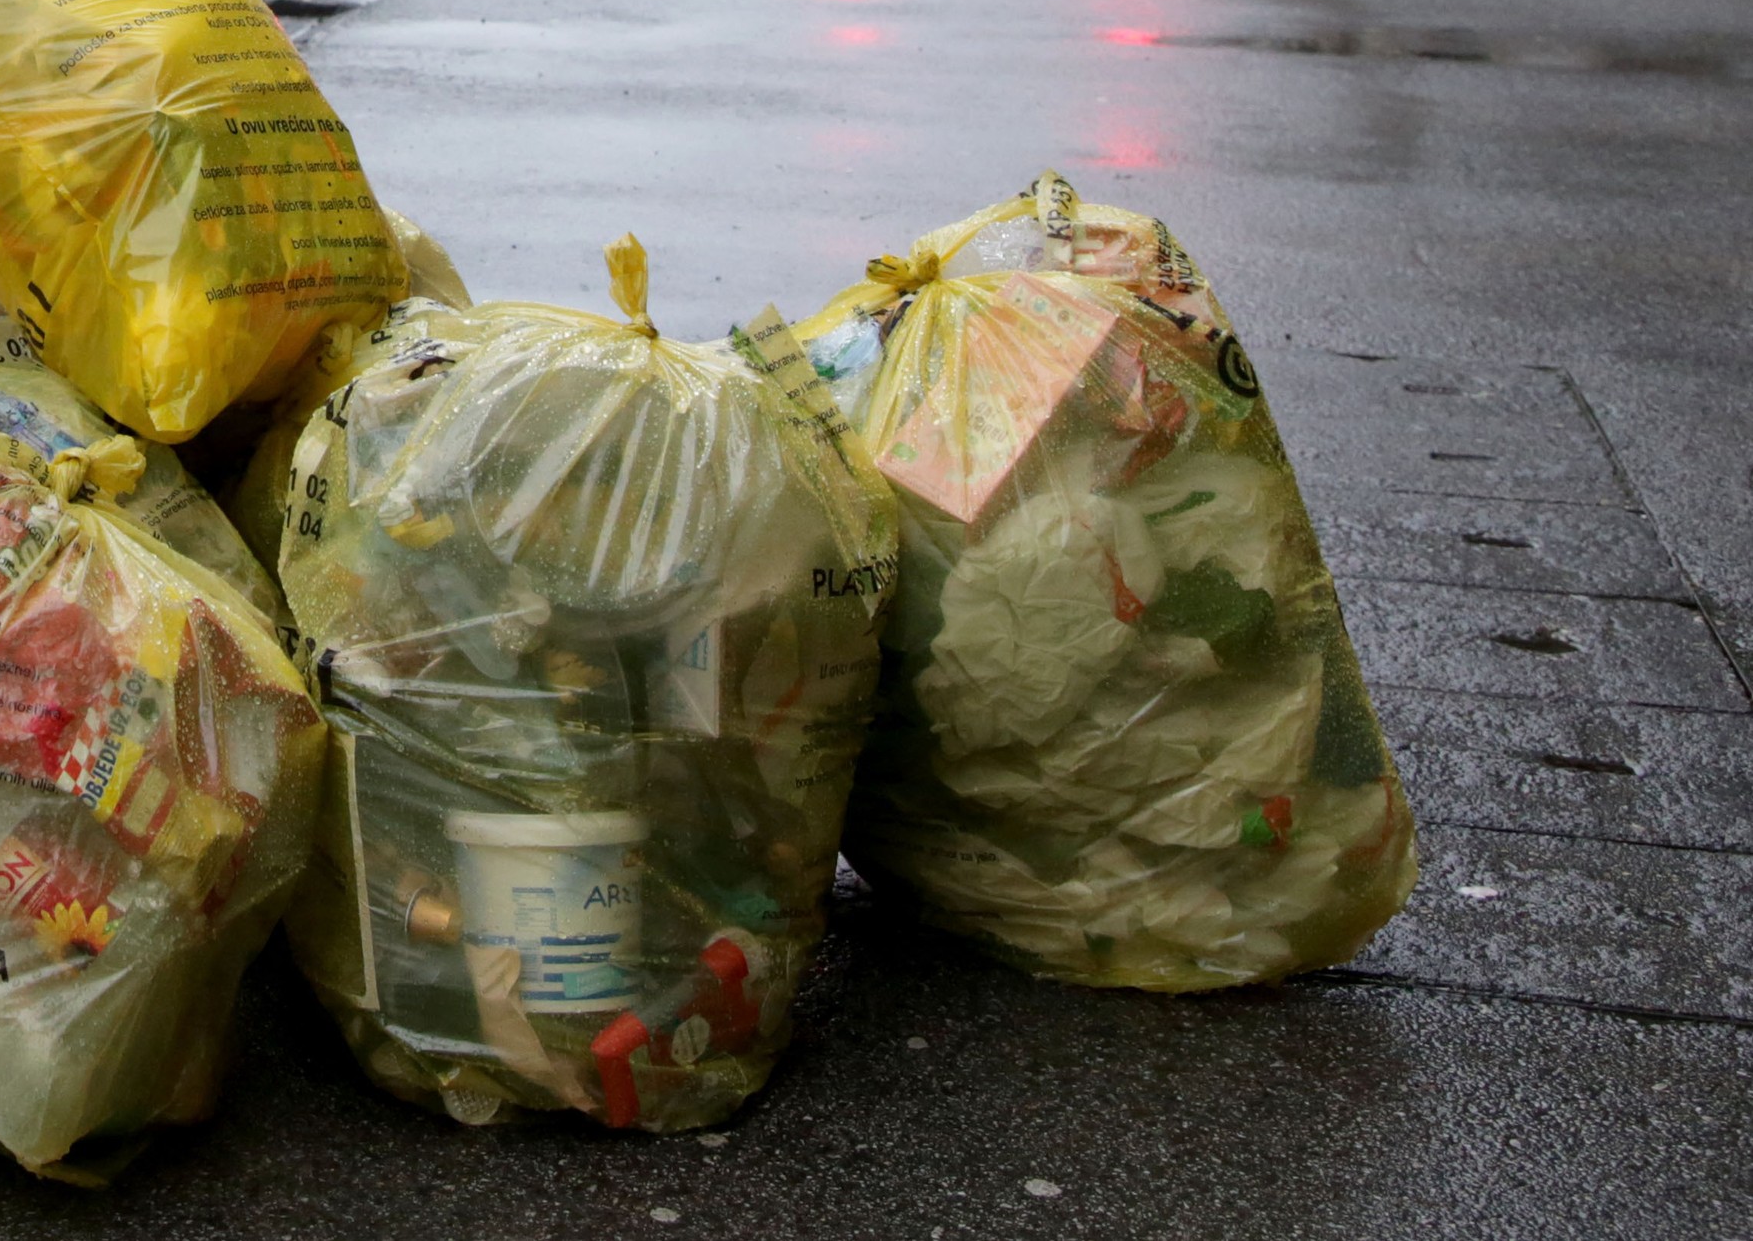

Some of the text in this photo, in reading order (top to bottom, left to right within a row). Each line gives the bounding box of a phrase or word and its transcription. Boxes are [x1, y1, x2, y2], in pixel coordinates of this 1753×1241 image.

[57, 29, 116, 77] podloške
[224, 118, 238, 135] U
[241, 120, 266, 134] ovu
[317, 119, 334, 132] ne
[200, 165, 235, 180] tapete,
[234, 205, 247, 215] za
[753, 322, 787, 342] spužve,
[305, 473, 329, 505] 02
[298, 511, 323, 542] 04
[30, 778, 61, 796] ulja,
